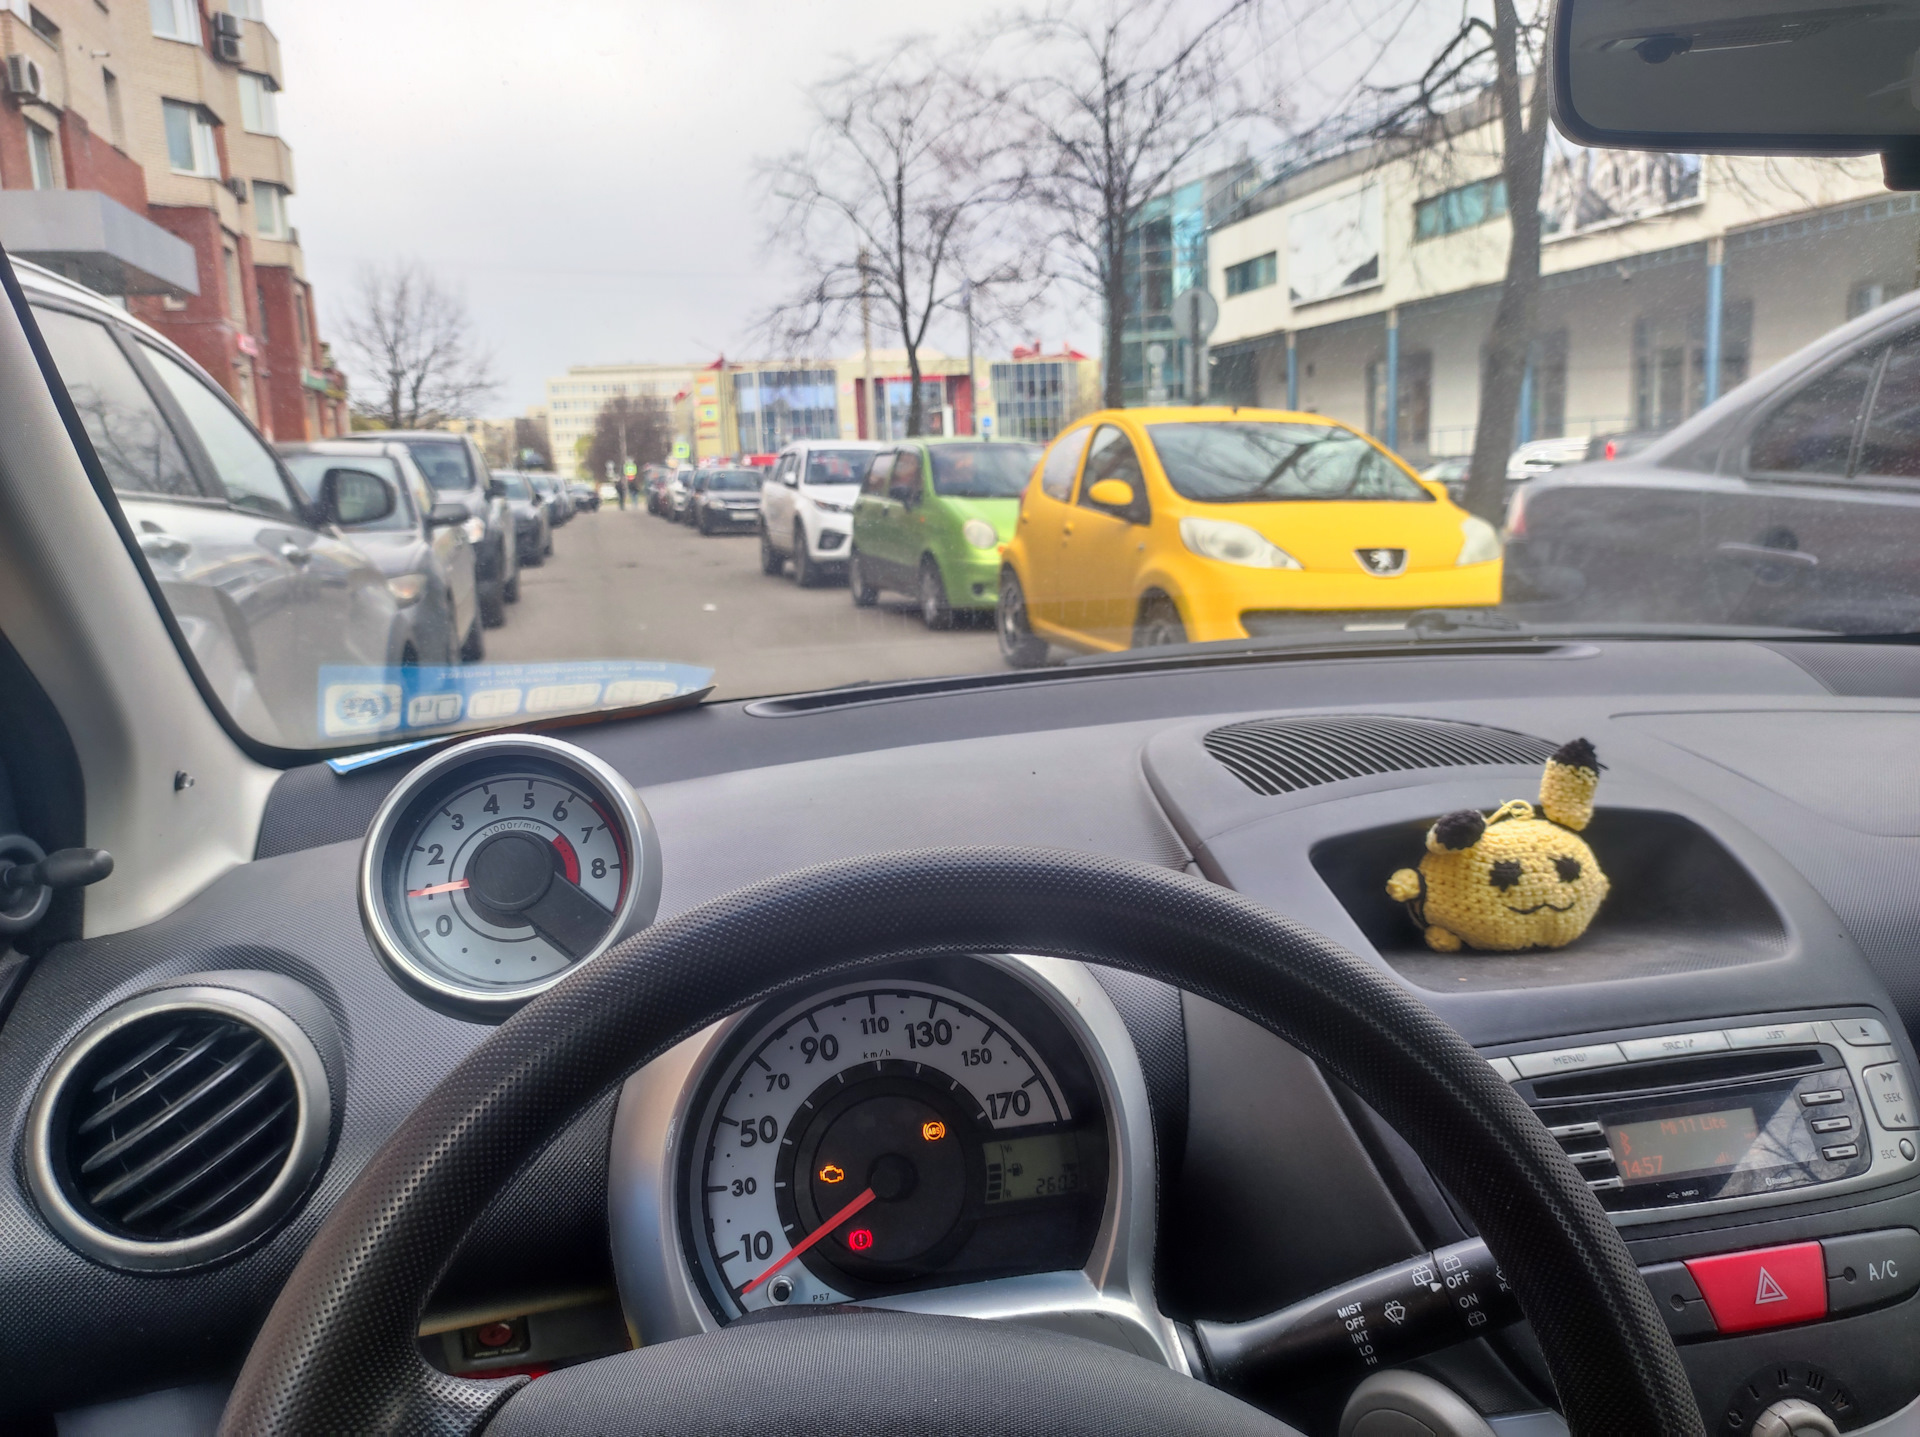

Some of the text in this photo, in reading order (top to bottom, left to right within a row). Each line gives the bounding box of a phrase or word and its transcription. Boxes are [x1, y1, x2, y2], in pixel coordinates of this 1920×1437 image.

[483, 794, 500, 815] 4
[523, 793, 535, 810] 5
[552, 801, 569, 822] 6
[451, 814, 465, 832] 3
[581, 827, 594, 844] 7
[428, 844, 445, 866] 2
[591, 858, 607, 879] 8
[436, 915, 453, 937] 0
[860, 1017, 890, 1035] 110
[905, 1018, 953, 1049] 130
[800, 1036, 839, 1065] 90
[863, 1049, 892, 1060] km/h
[961, 1049, 993, 1067] 150
[1553, 1053, 1586, 1066] MENU
[765, 1074, 790, 1092] 70
[986, 1090, 1031, 1120] 170
[1883, 1092, 1904, 1103] SEEK
[740, 1115, 778, 1148] 50
[928, 1127, 940, 1136] ABS
[1660, 1116, 1728, 1136] Mi 11 Lite
[1881, 1149, 1897, 1160] ESC
[732, 1178, 757, 1197] 30
[1682, 1189, 1700, 1198] MP3
[740, 1230, 773, 1263] 10
[1869, 1260, 1899, 1281] A/C
[1446, 1271, 1471, 1290] OFF
[812, 1292, 831, 1303] P57
[1458, 1293, 1480, 1309] ON
[1337, 1302, 1363, 1319] MIST
[1345, 1316, 1366, 1332] OFF
[1351, 1330, 1370, 1344] INT
[1360, 1344, 1374, 1356] LO
[1366, 1355, 1378, 1366] HI
[1805, 1370, 1824, 1393] III
